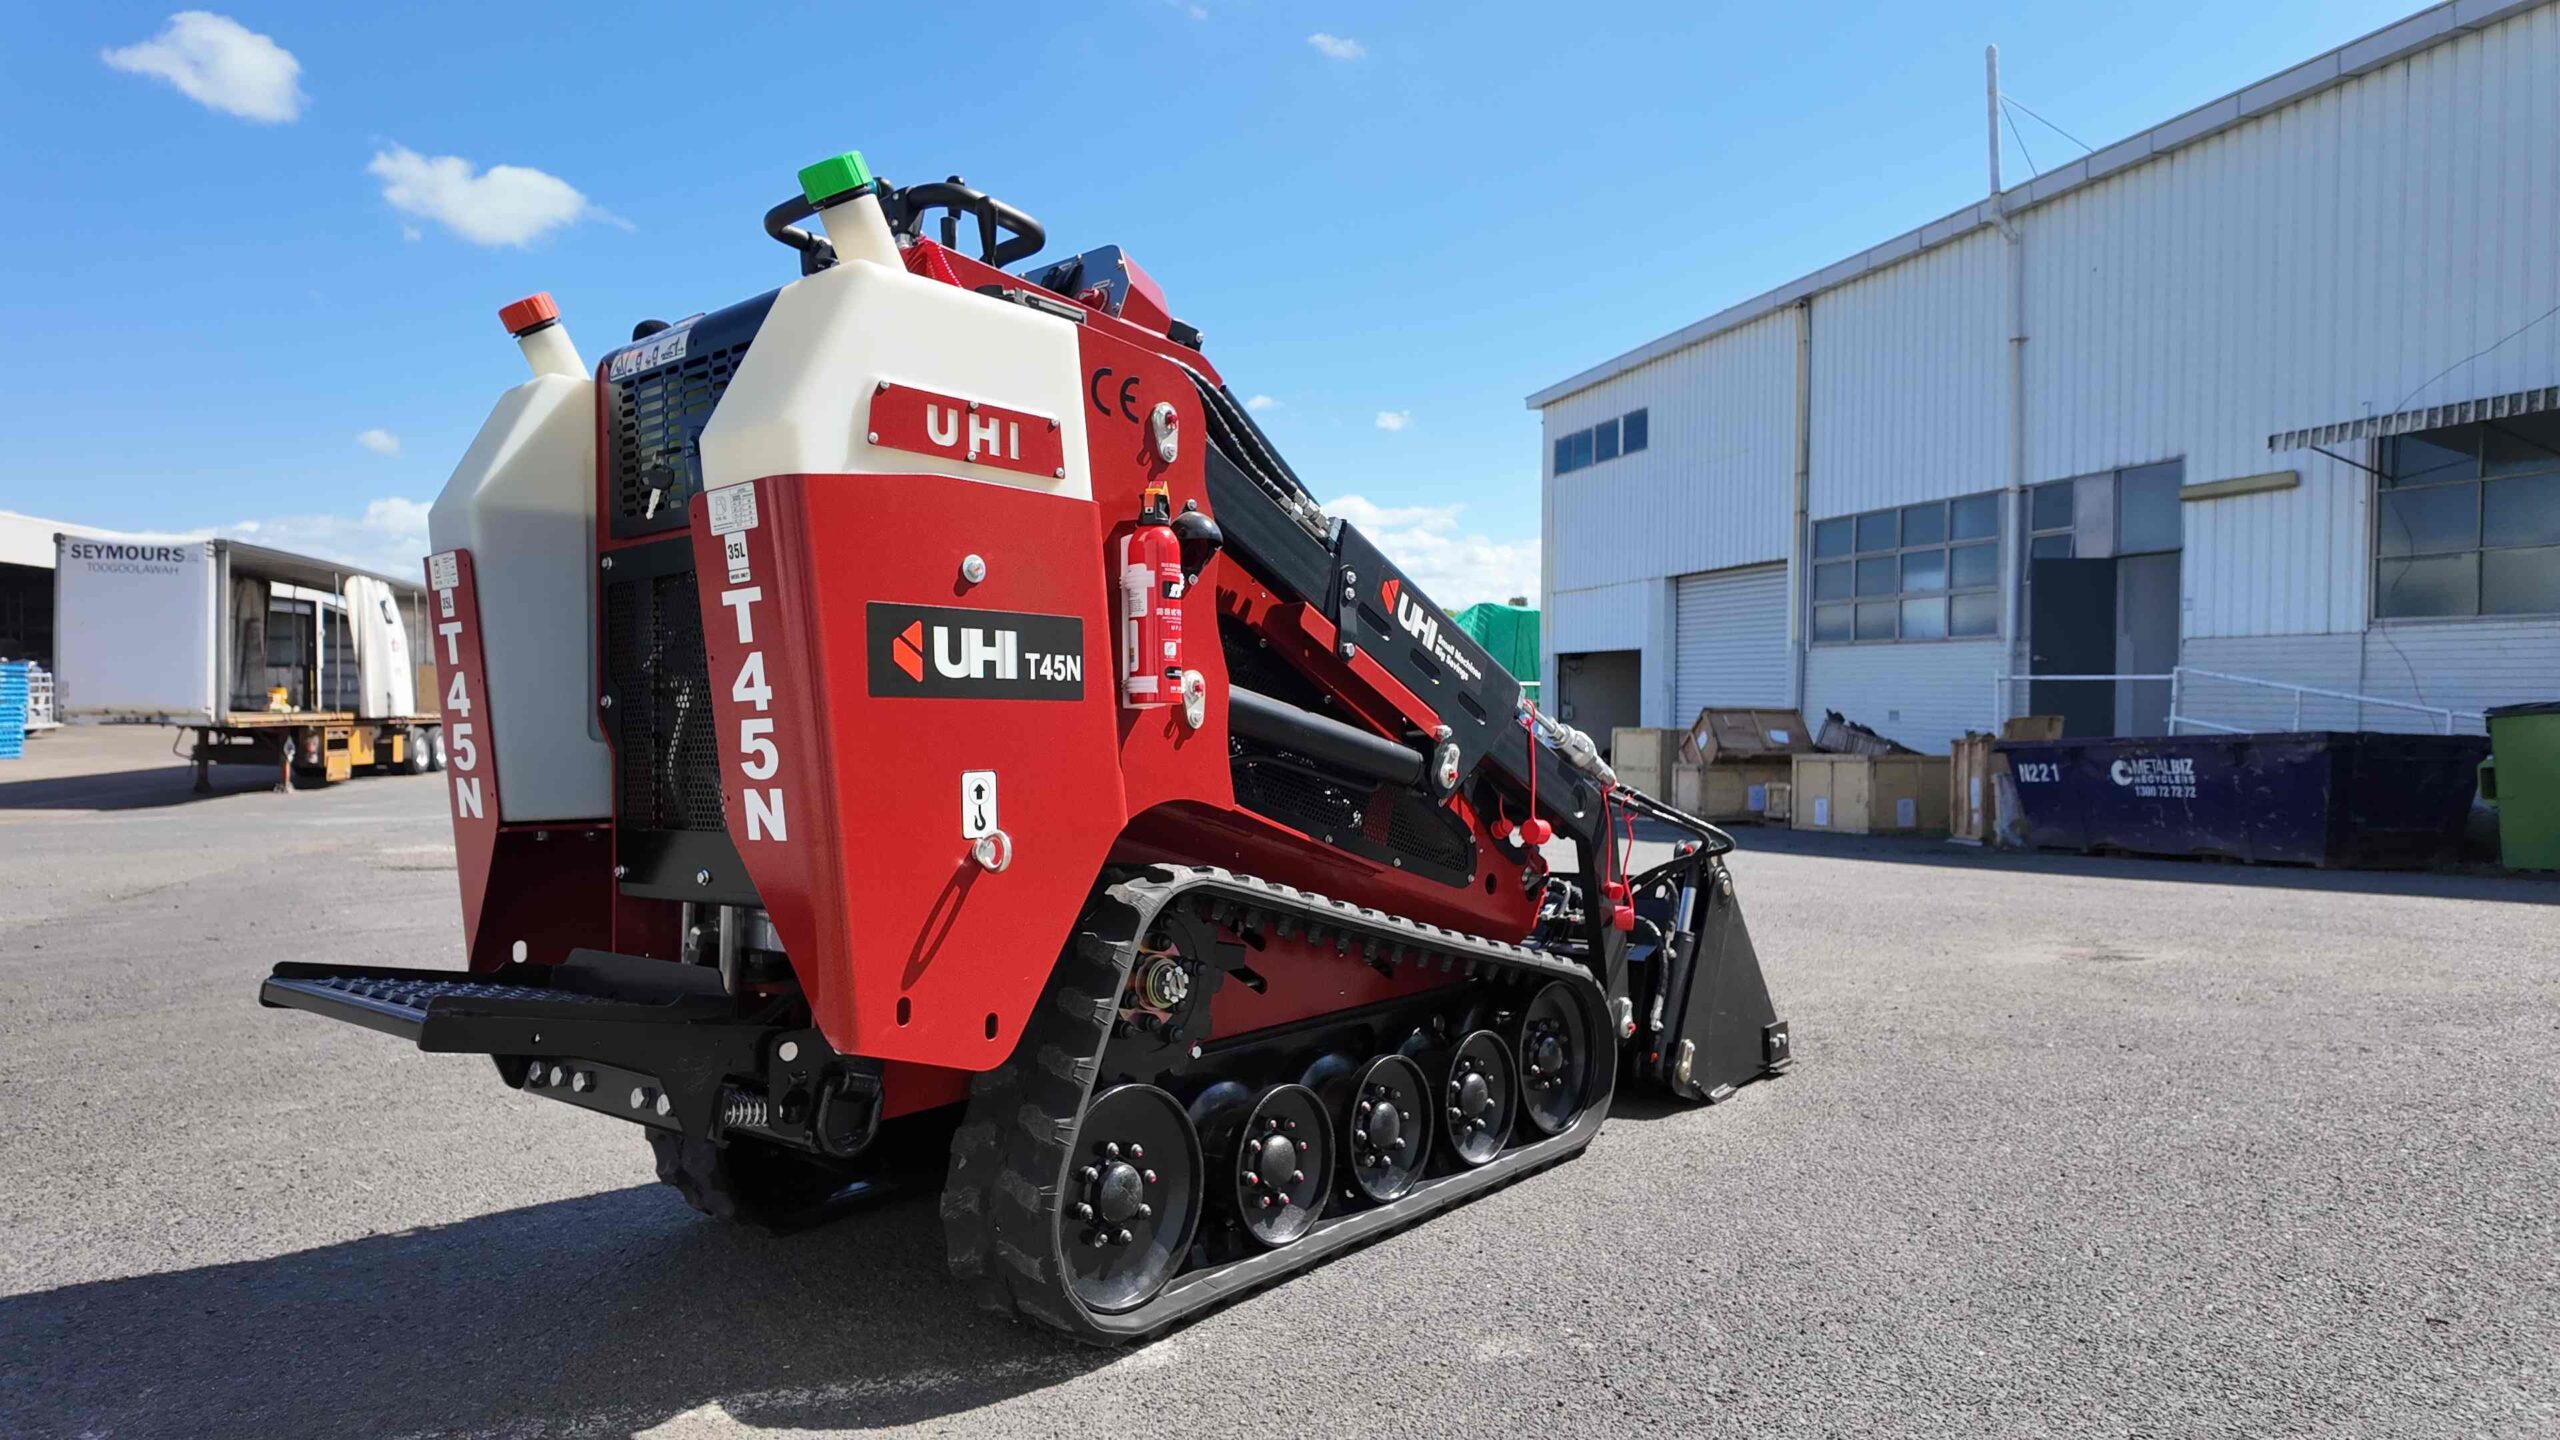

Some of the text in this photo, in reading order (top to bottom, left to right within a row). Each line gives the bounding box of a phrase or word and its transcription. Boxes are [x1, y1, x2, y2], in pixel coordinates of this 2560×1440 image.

[1091, 367, 1140, 424] CE
[926, 403, 1020, 460] UHI
[71, 544, 185, 562] SEYMOURS
[87, 562, 179, 575] TOOGOOLAWAH
[727, 541, 746, 560] 35L
[1397, 592, 1438, 652] UHI
[933, 625, 1082, 682] UHI T45N
[1434, 644, 1469, 681] Big Savings
[1437, 634, 1482, 680] Small Machines
[2018, 763, 2060, 783] N221
[2135, 785, 2197, 799] 1300 72 72 72
